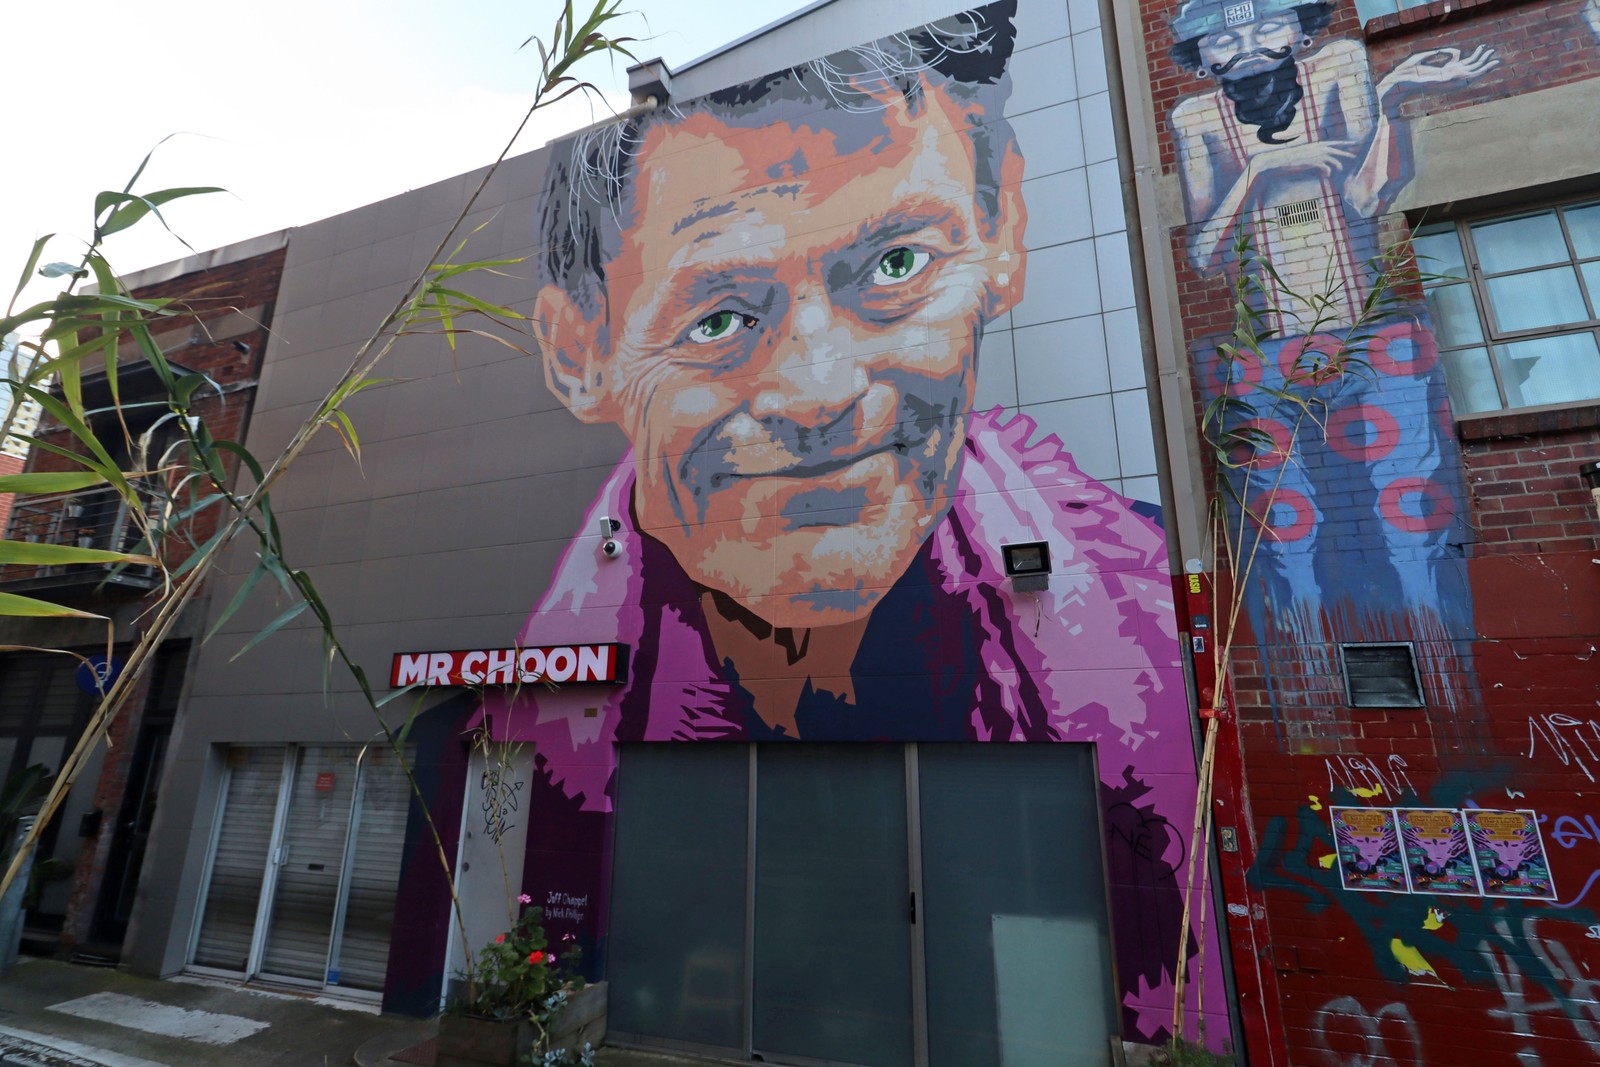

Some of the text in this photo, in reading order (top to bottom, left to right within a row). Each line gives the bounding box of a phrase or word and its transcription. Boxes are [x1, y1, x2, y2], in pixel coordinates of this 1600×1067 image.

[397, 645, 609, 687] MR CHOON
[547, 891, 562, 904] Jeff
